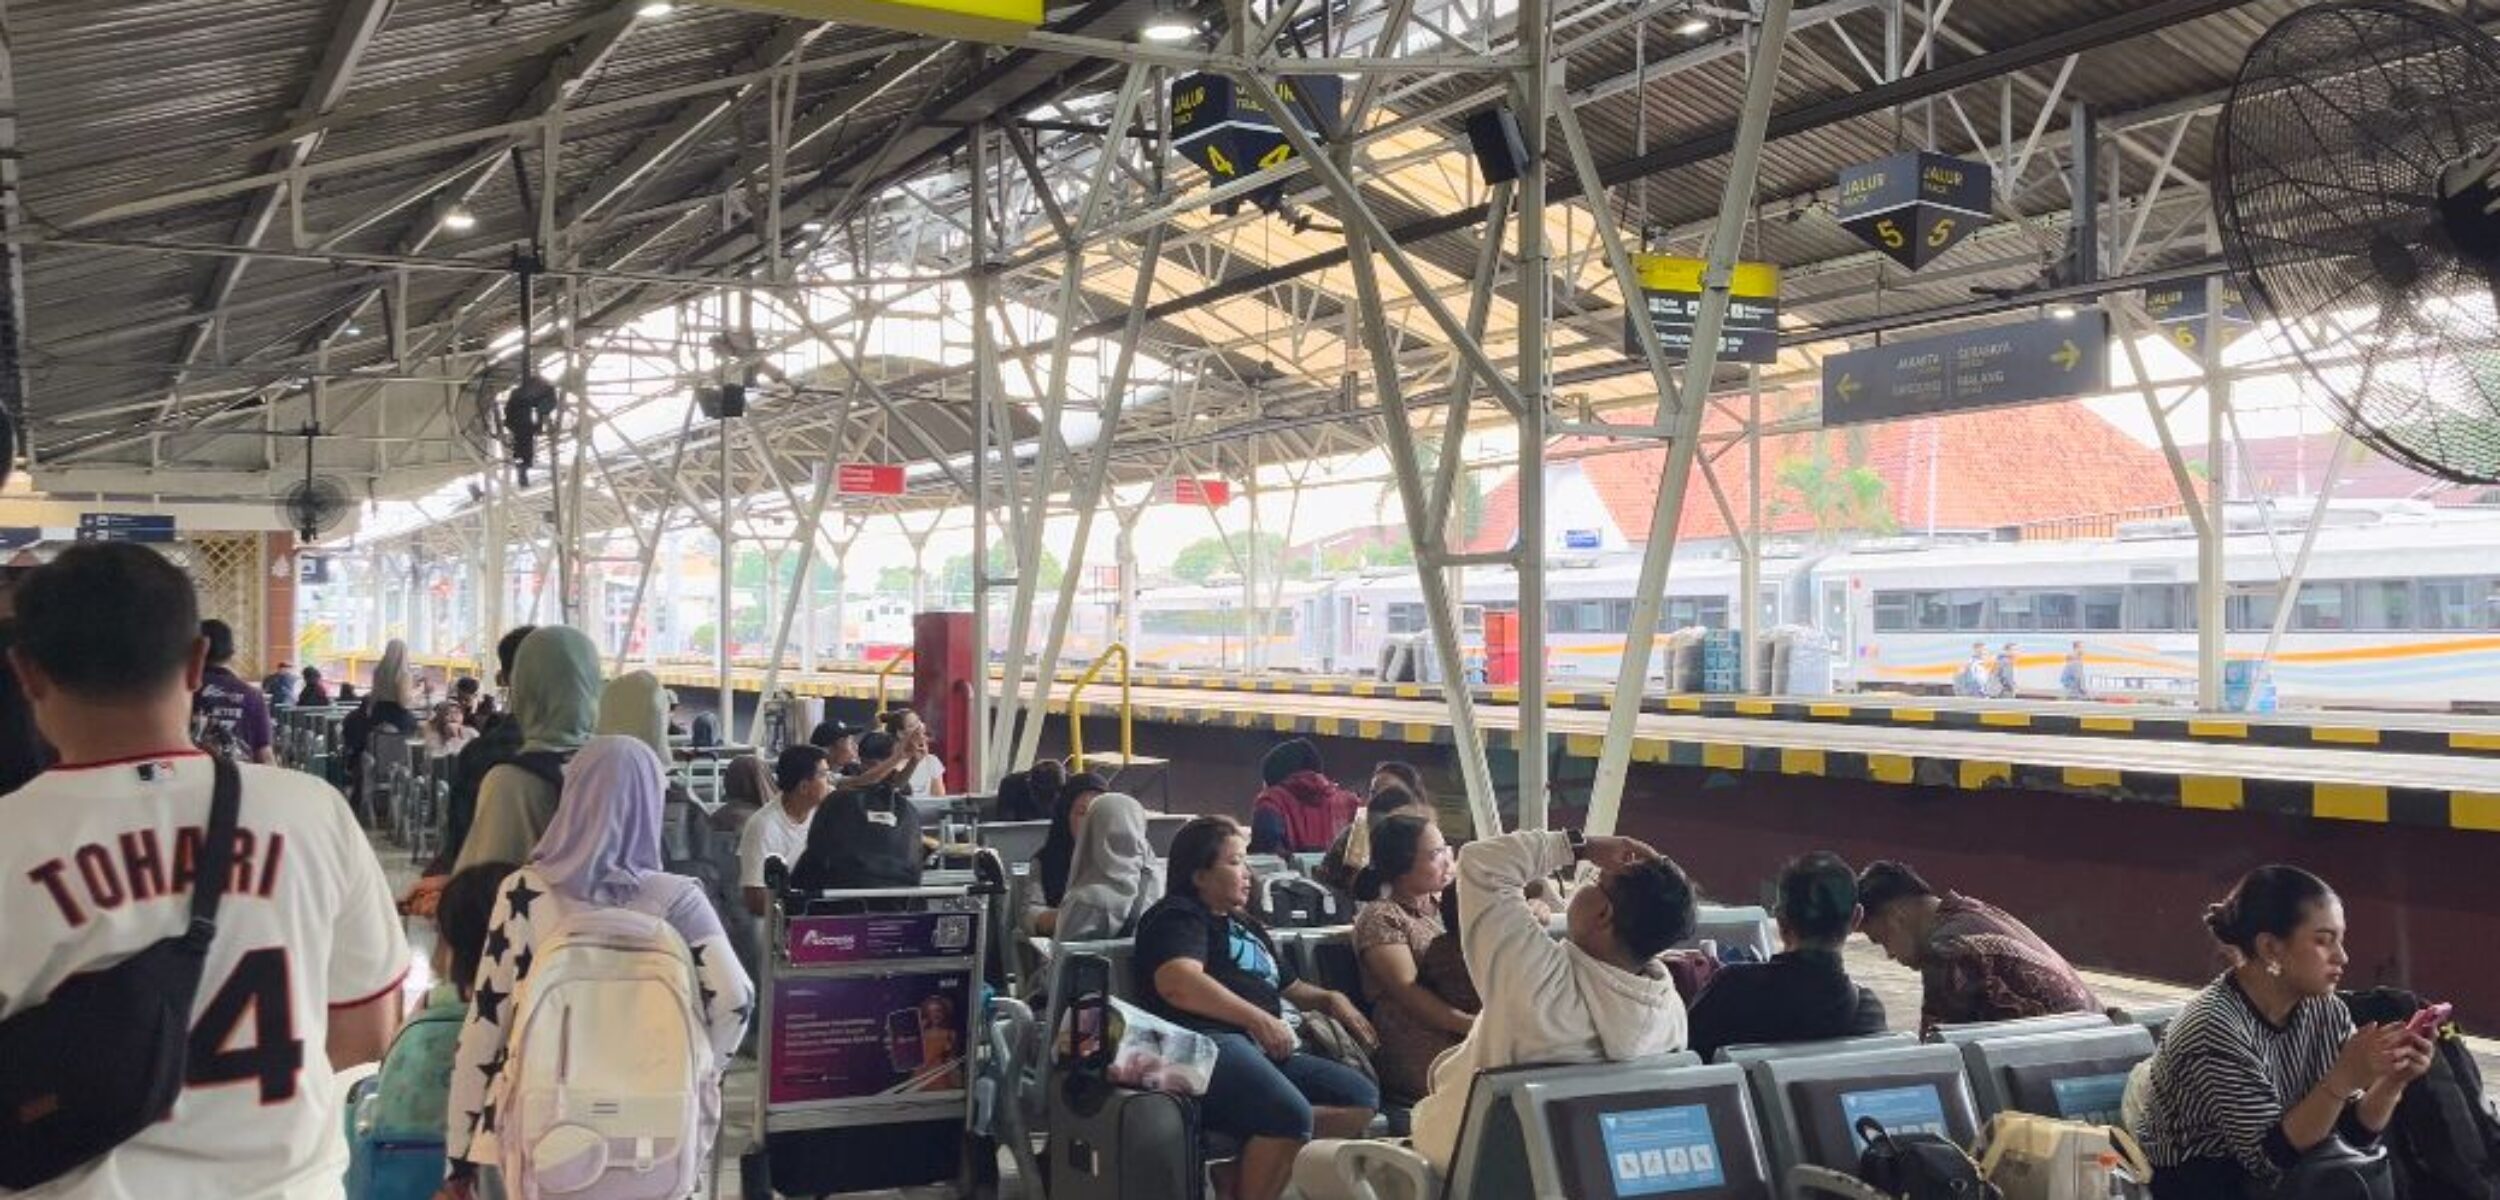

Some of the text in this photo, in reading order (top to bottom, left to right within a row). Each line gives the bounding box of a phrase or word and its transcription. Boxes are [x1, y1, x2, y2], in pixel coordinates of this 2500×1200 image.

[1207, 144, 1235, 176] 4
[1258, 143, 1290, 171] 4
[1843, 173, 1886, 197] JALUR
[1876, 219, 1904, 249] 5
[1927, 218, 1955, 247] 5
[2175, 325, 2196, 349] 6
[27, 826, 284, 928] TOHARI
